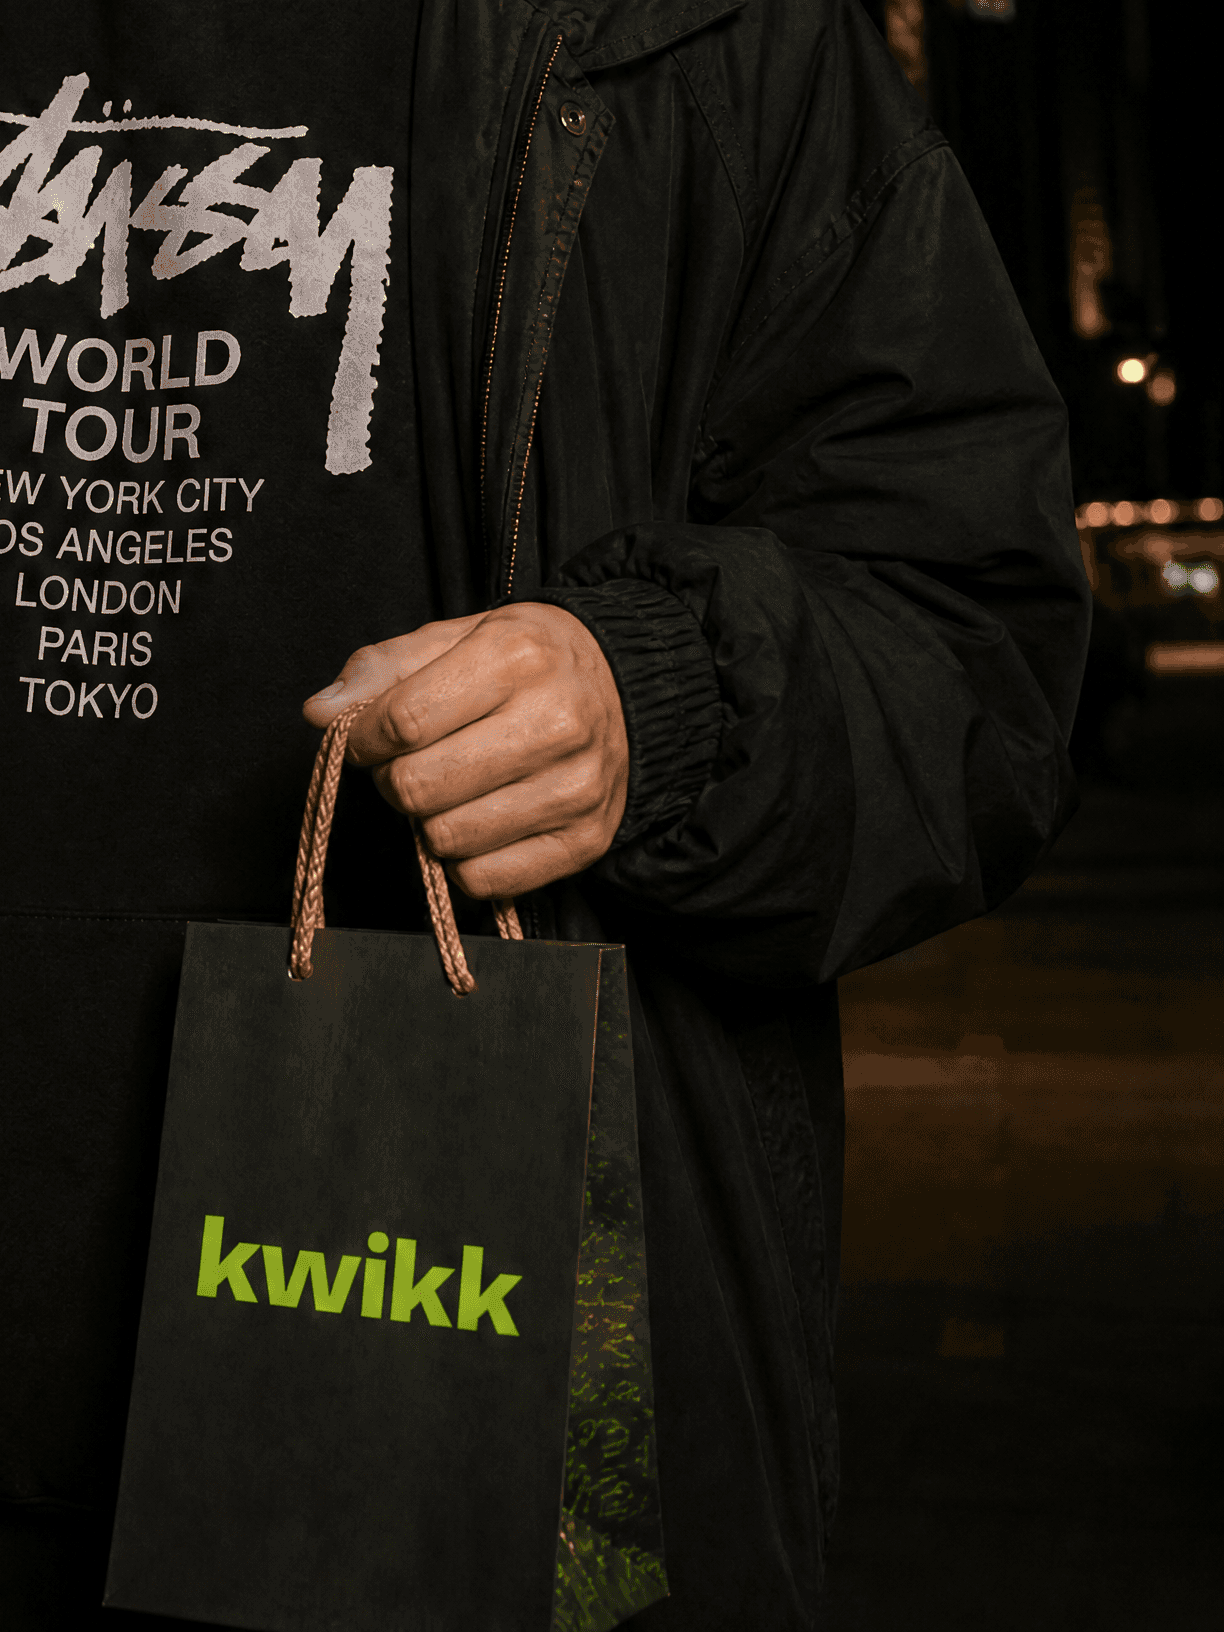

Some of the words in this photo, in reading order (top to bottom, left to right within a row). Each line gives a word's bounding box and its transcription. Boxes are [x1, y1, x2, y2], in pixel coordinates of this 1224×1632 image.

[22, 398, 200, 463] TOUR
[60, 476, 165, 514] YORK
[177, 478, 265, 512] CITY
[56, 528, 232, 564] ANGELES
[16, 572, 181, 615] LONDON
[38, 626, 152, 666] PARIS
[19, 677, 158, 719] TOKYO
[197, 1215, 522, 1336] kwikk
